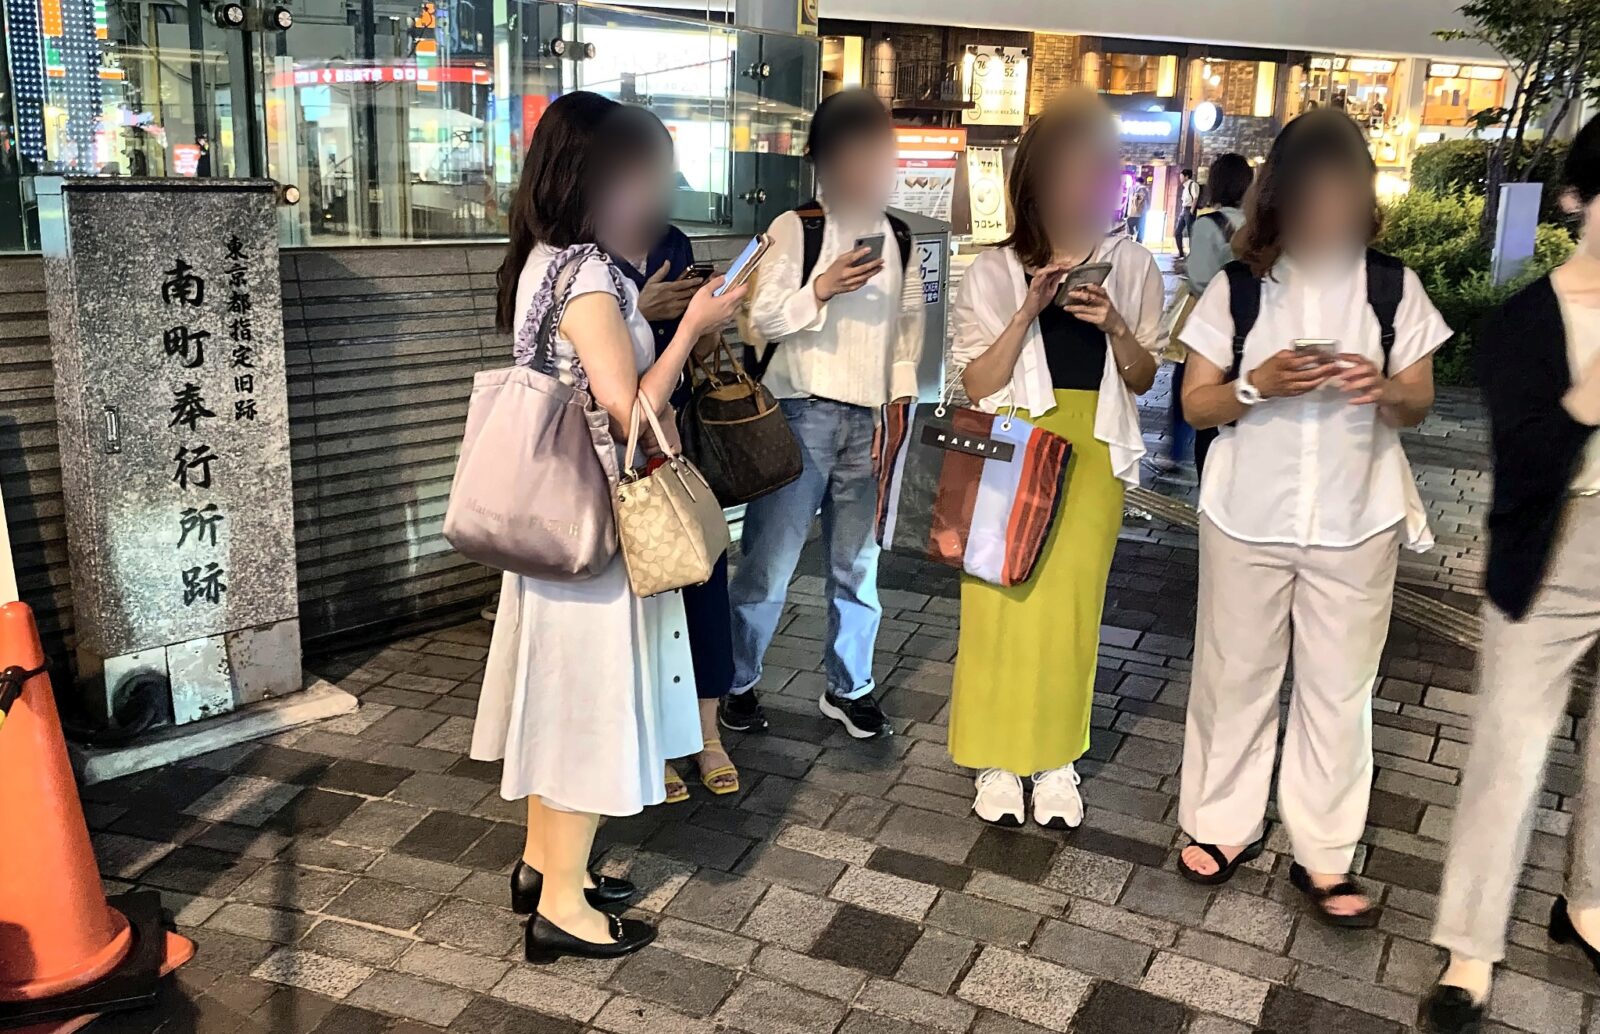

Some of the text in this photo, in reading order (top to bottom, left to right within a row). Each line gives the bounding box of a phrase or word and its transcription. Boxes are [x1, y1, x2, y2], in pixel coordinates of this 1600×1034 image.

[974, 220, 1002, 229] フロント
[224, 235, 258, 421] 東京都指定旧跡
[161, 258, 227, 606] 南町奉行所跡
[937, 434, 998, 454] MARNI
